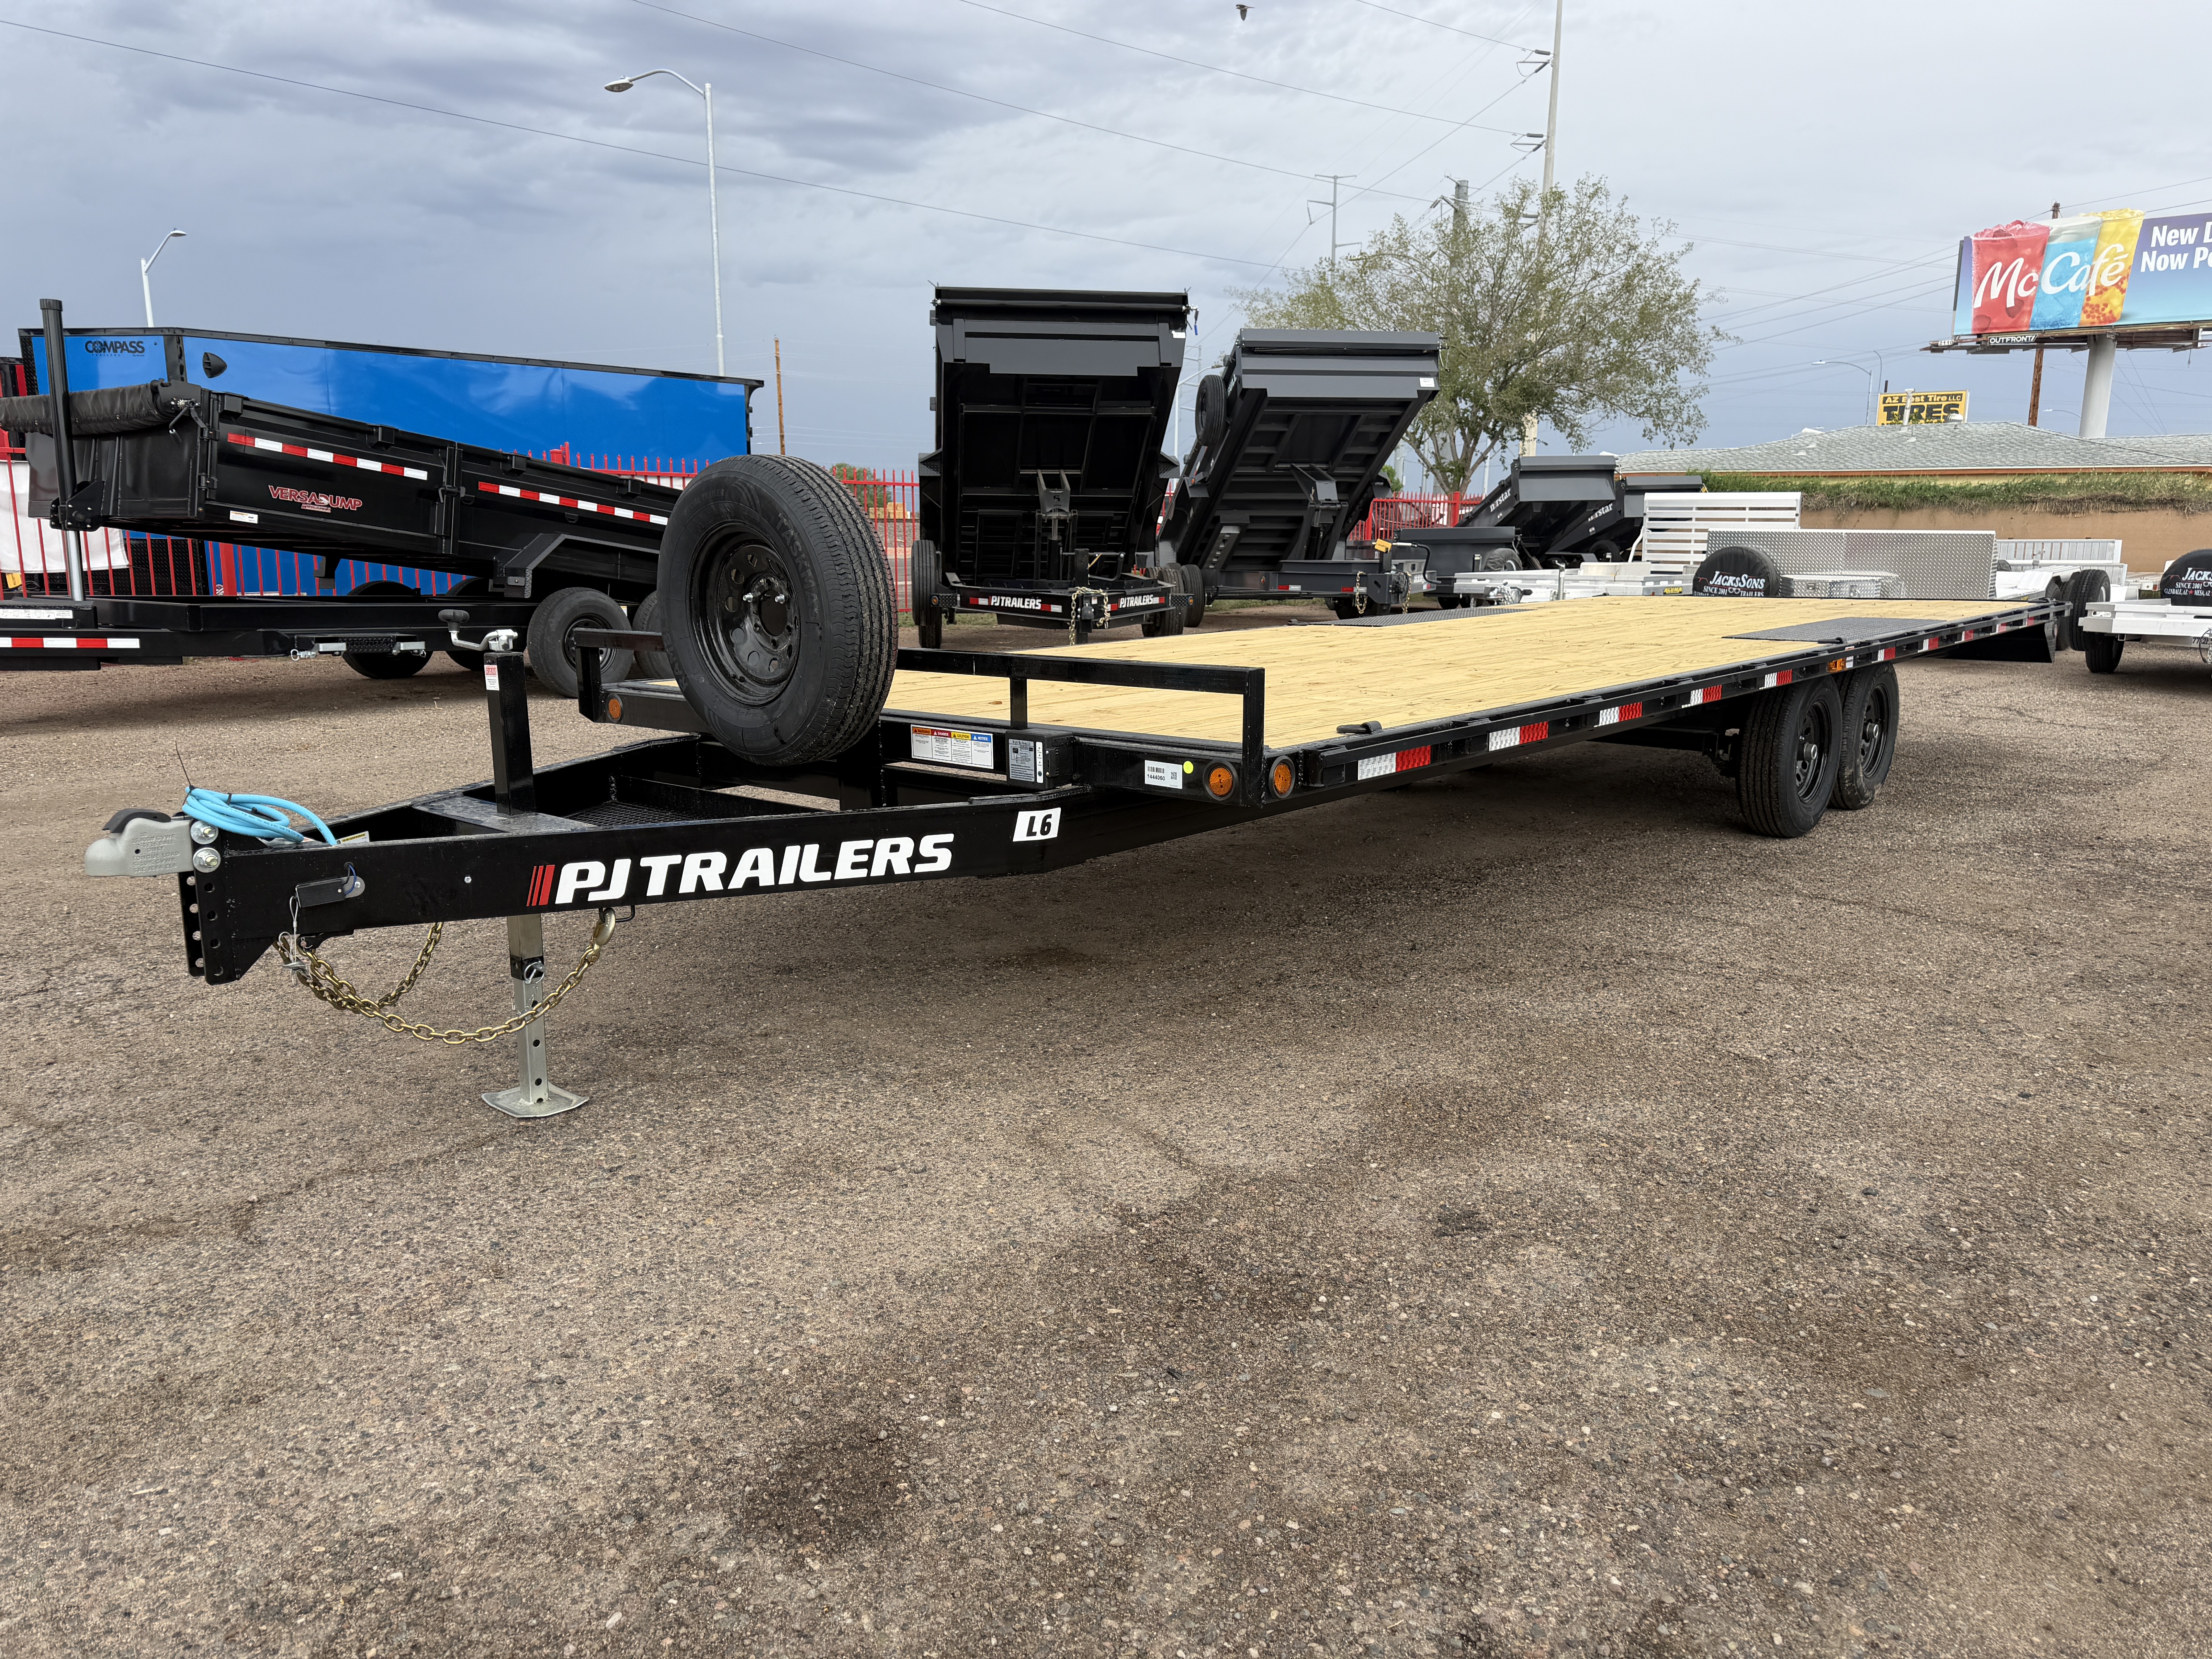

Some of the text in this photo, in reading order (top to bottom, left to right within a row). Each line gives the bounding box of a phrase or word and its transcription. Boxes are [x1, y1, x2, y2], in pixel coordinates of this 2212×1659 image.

[2151, 225, 2199, 247] New
[2140, 251, 2189, 272] Now
[1973, 244, 2129, 308] McCafé
[85, 340, 145, 354] COMPASS
[268, 485, 362, 511] VERSADUMP
[1703, 586, 1717, 594] SINCE
[1026, 814, 1052, 837] L6
